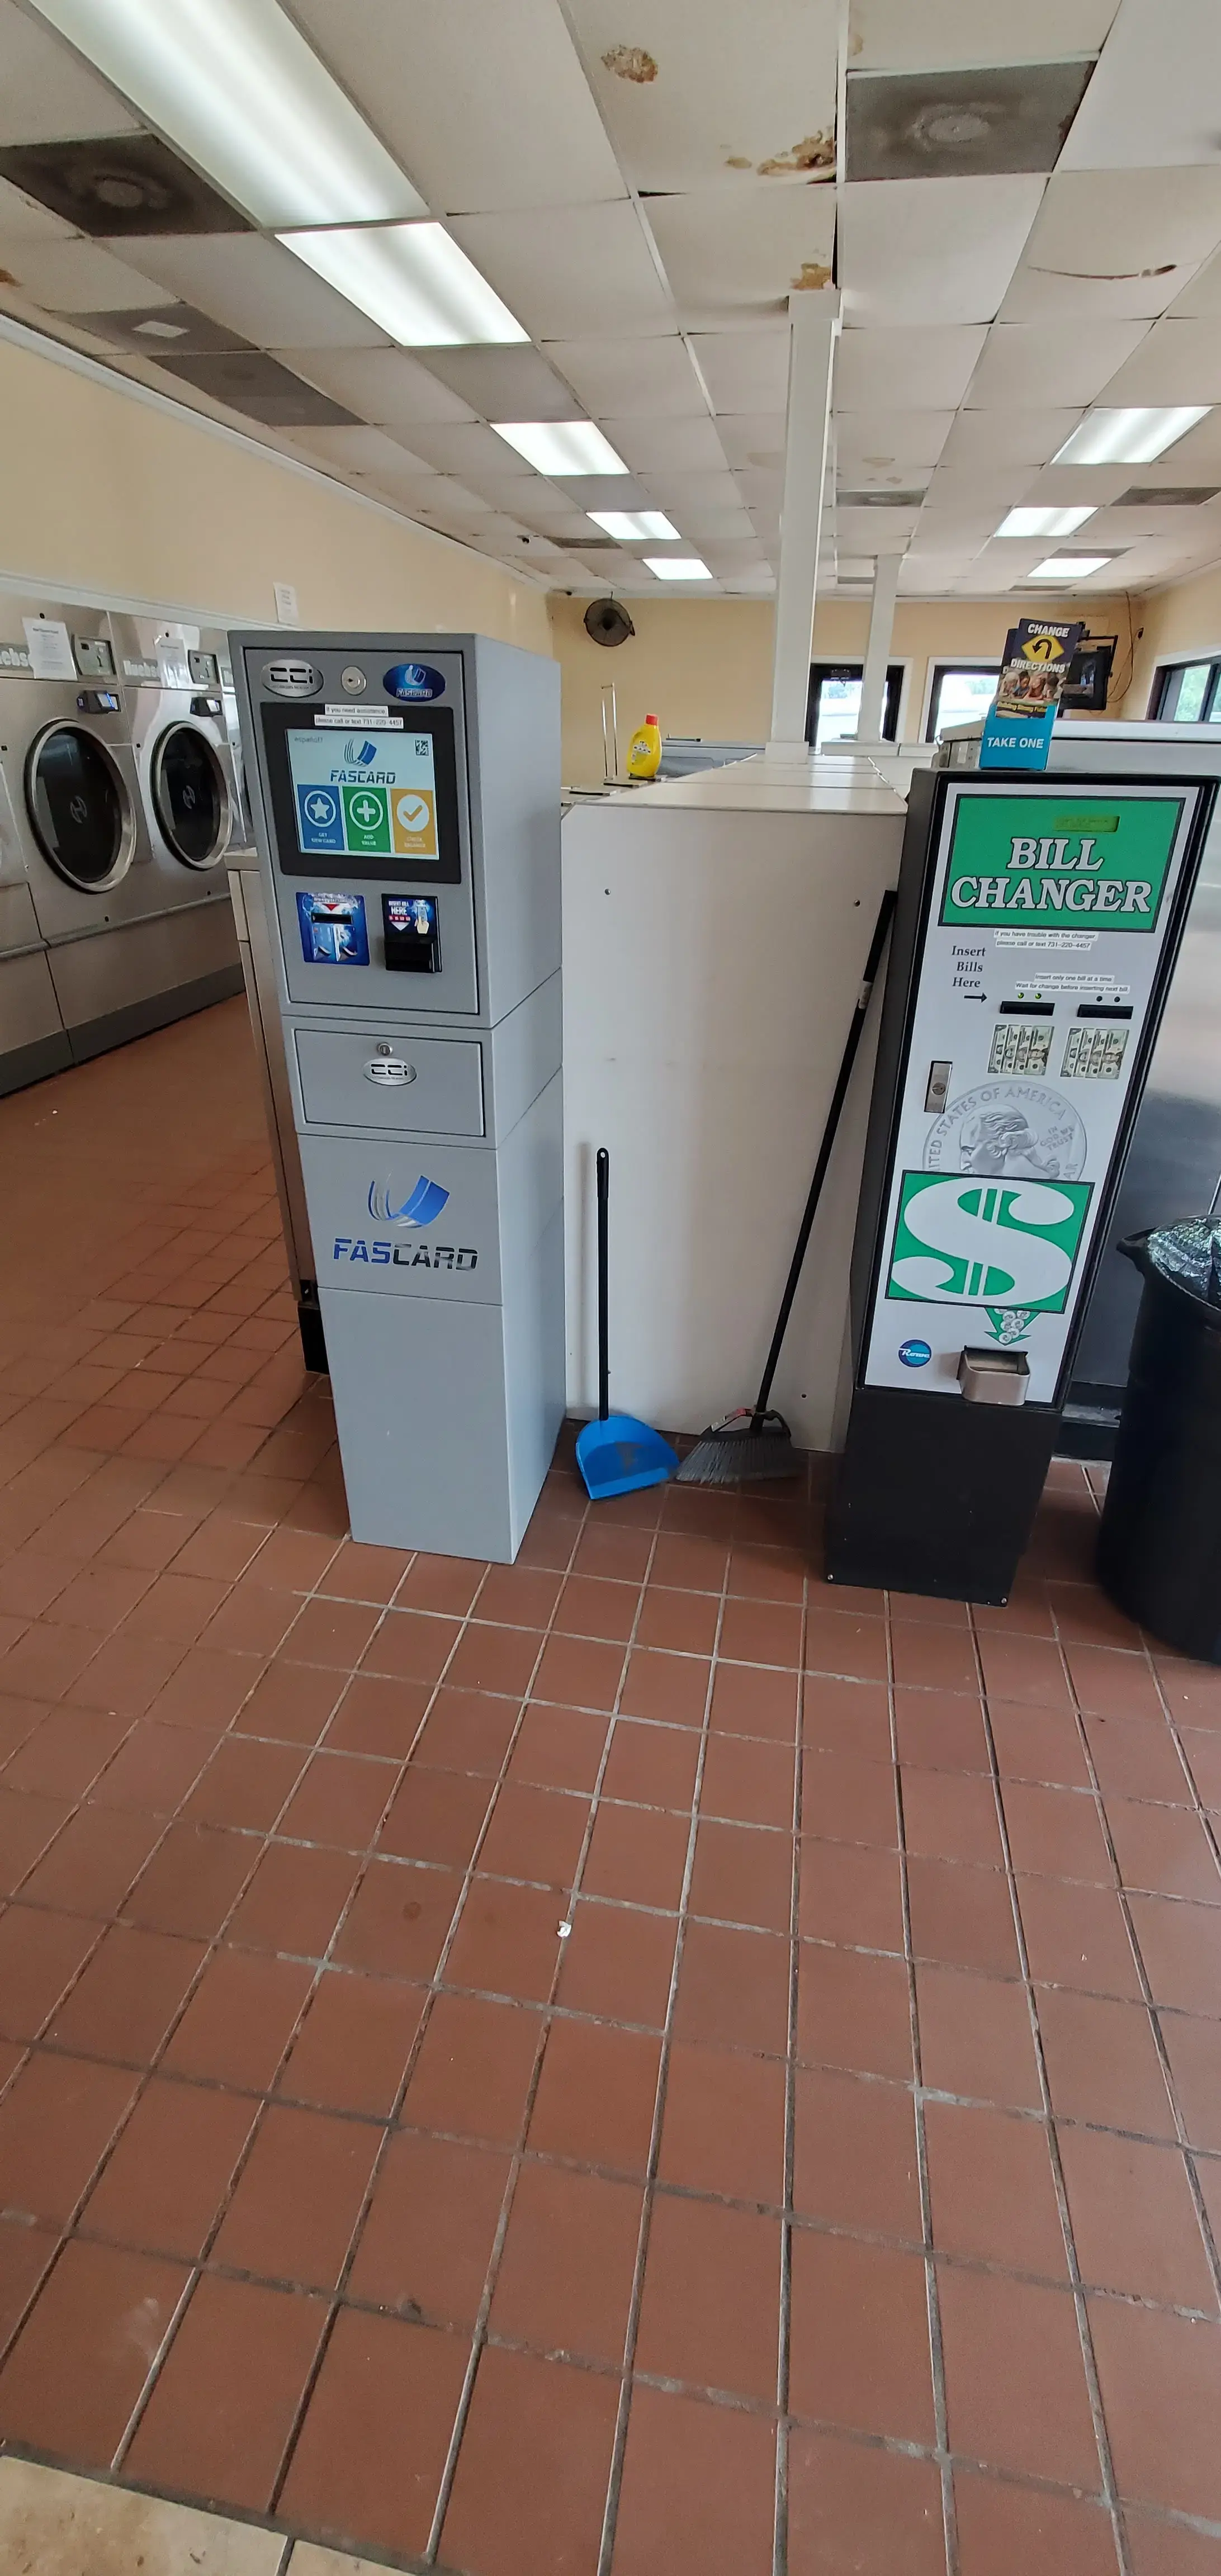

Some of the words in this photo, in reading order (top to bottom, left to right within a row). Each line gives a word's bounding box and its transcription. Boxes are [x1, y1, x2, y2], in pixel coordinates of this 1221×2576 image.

[1028, 623, 1070, 637] CHANGE
[1011, 659, 1066, 674] DIRECTIONS
[987, 737, 1016, 747] TAKE
[1019, 738, 1044, 749] ONE
[330, 770, 396, 784] FASCARD
[1006, 837, 1104, 870] BILL
[951, 877, 1152, 912] CHANGER
[391, 906, 408, 915] HERE
[952, 945, 986, 956] Insert
[957, 962, 983, 972] Bills
[953, 977, 981, 988] Here
[936, 1096, 977, 1137] STATES
[980, 1087, 1000, 1101] OF
[1005, 1086, 1066, 1120] AMERICA
[334, 1238, 478, 1271] FASCARD
